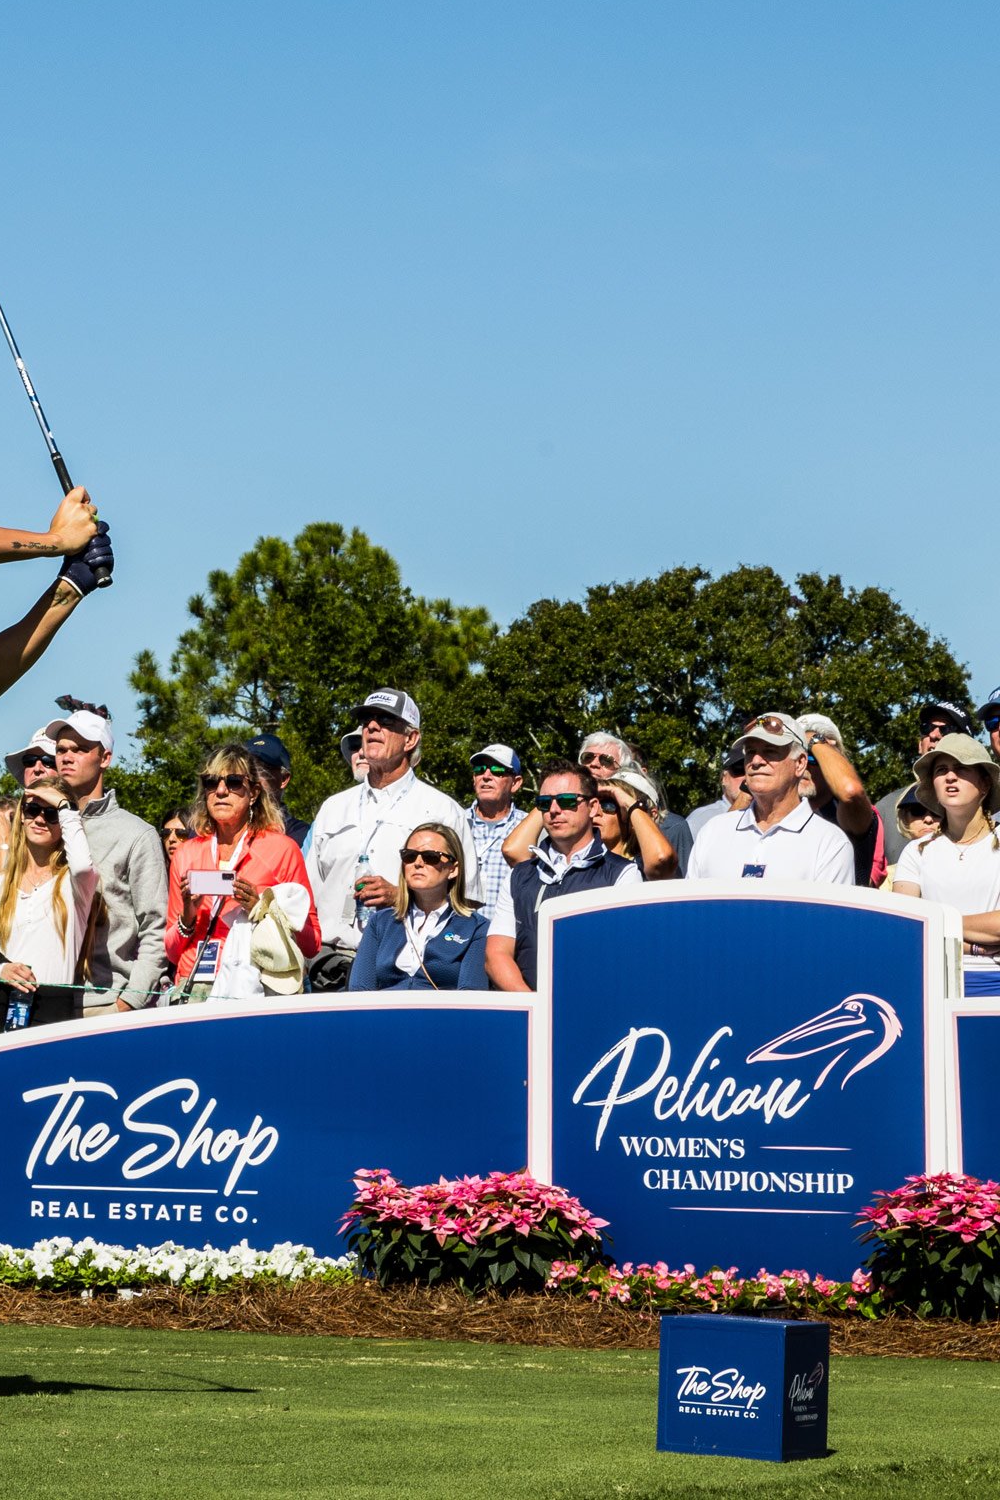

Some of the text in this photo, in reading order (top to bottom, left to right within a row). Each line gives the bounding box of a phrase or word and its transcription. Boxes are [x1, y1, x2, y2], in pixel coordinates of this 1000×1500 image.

[572, 1026, 811, 1152] Pelican
[22, 1076, 279, 1197] The Shop
[619, 1136, 745, 1159] WOMEN'S
[643, 1169, 854, 1194] CHAMPIONSHIP
[30, 1200, 258, 1224] REAL ESTATE CO.
[676, 1365, 767, 1410] The Shop
[679, 1406, 759, 1419] REAL ESTATE CO.
